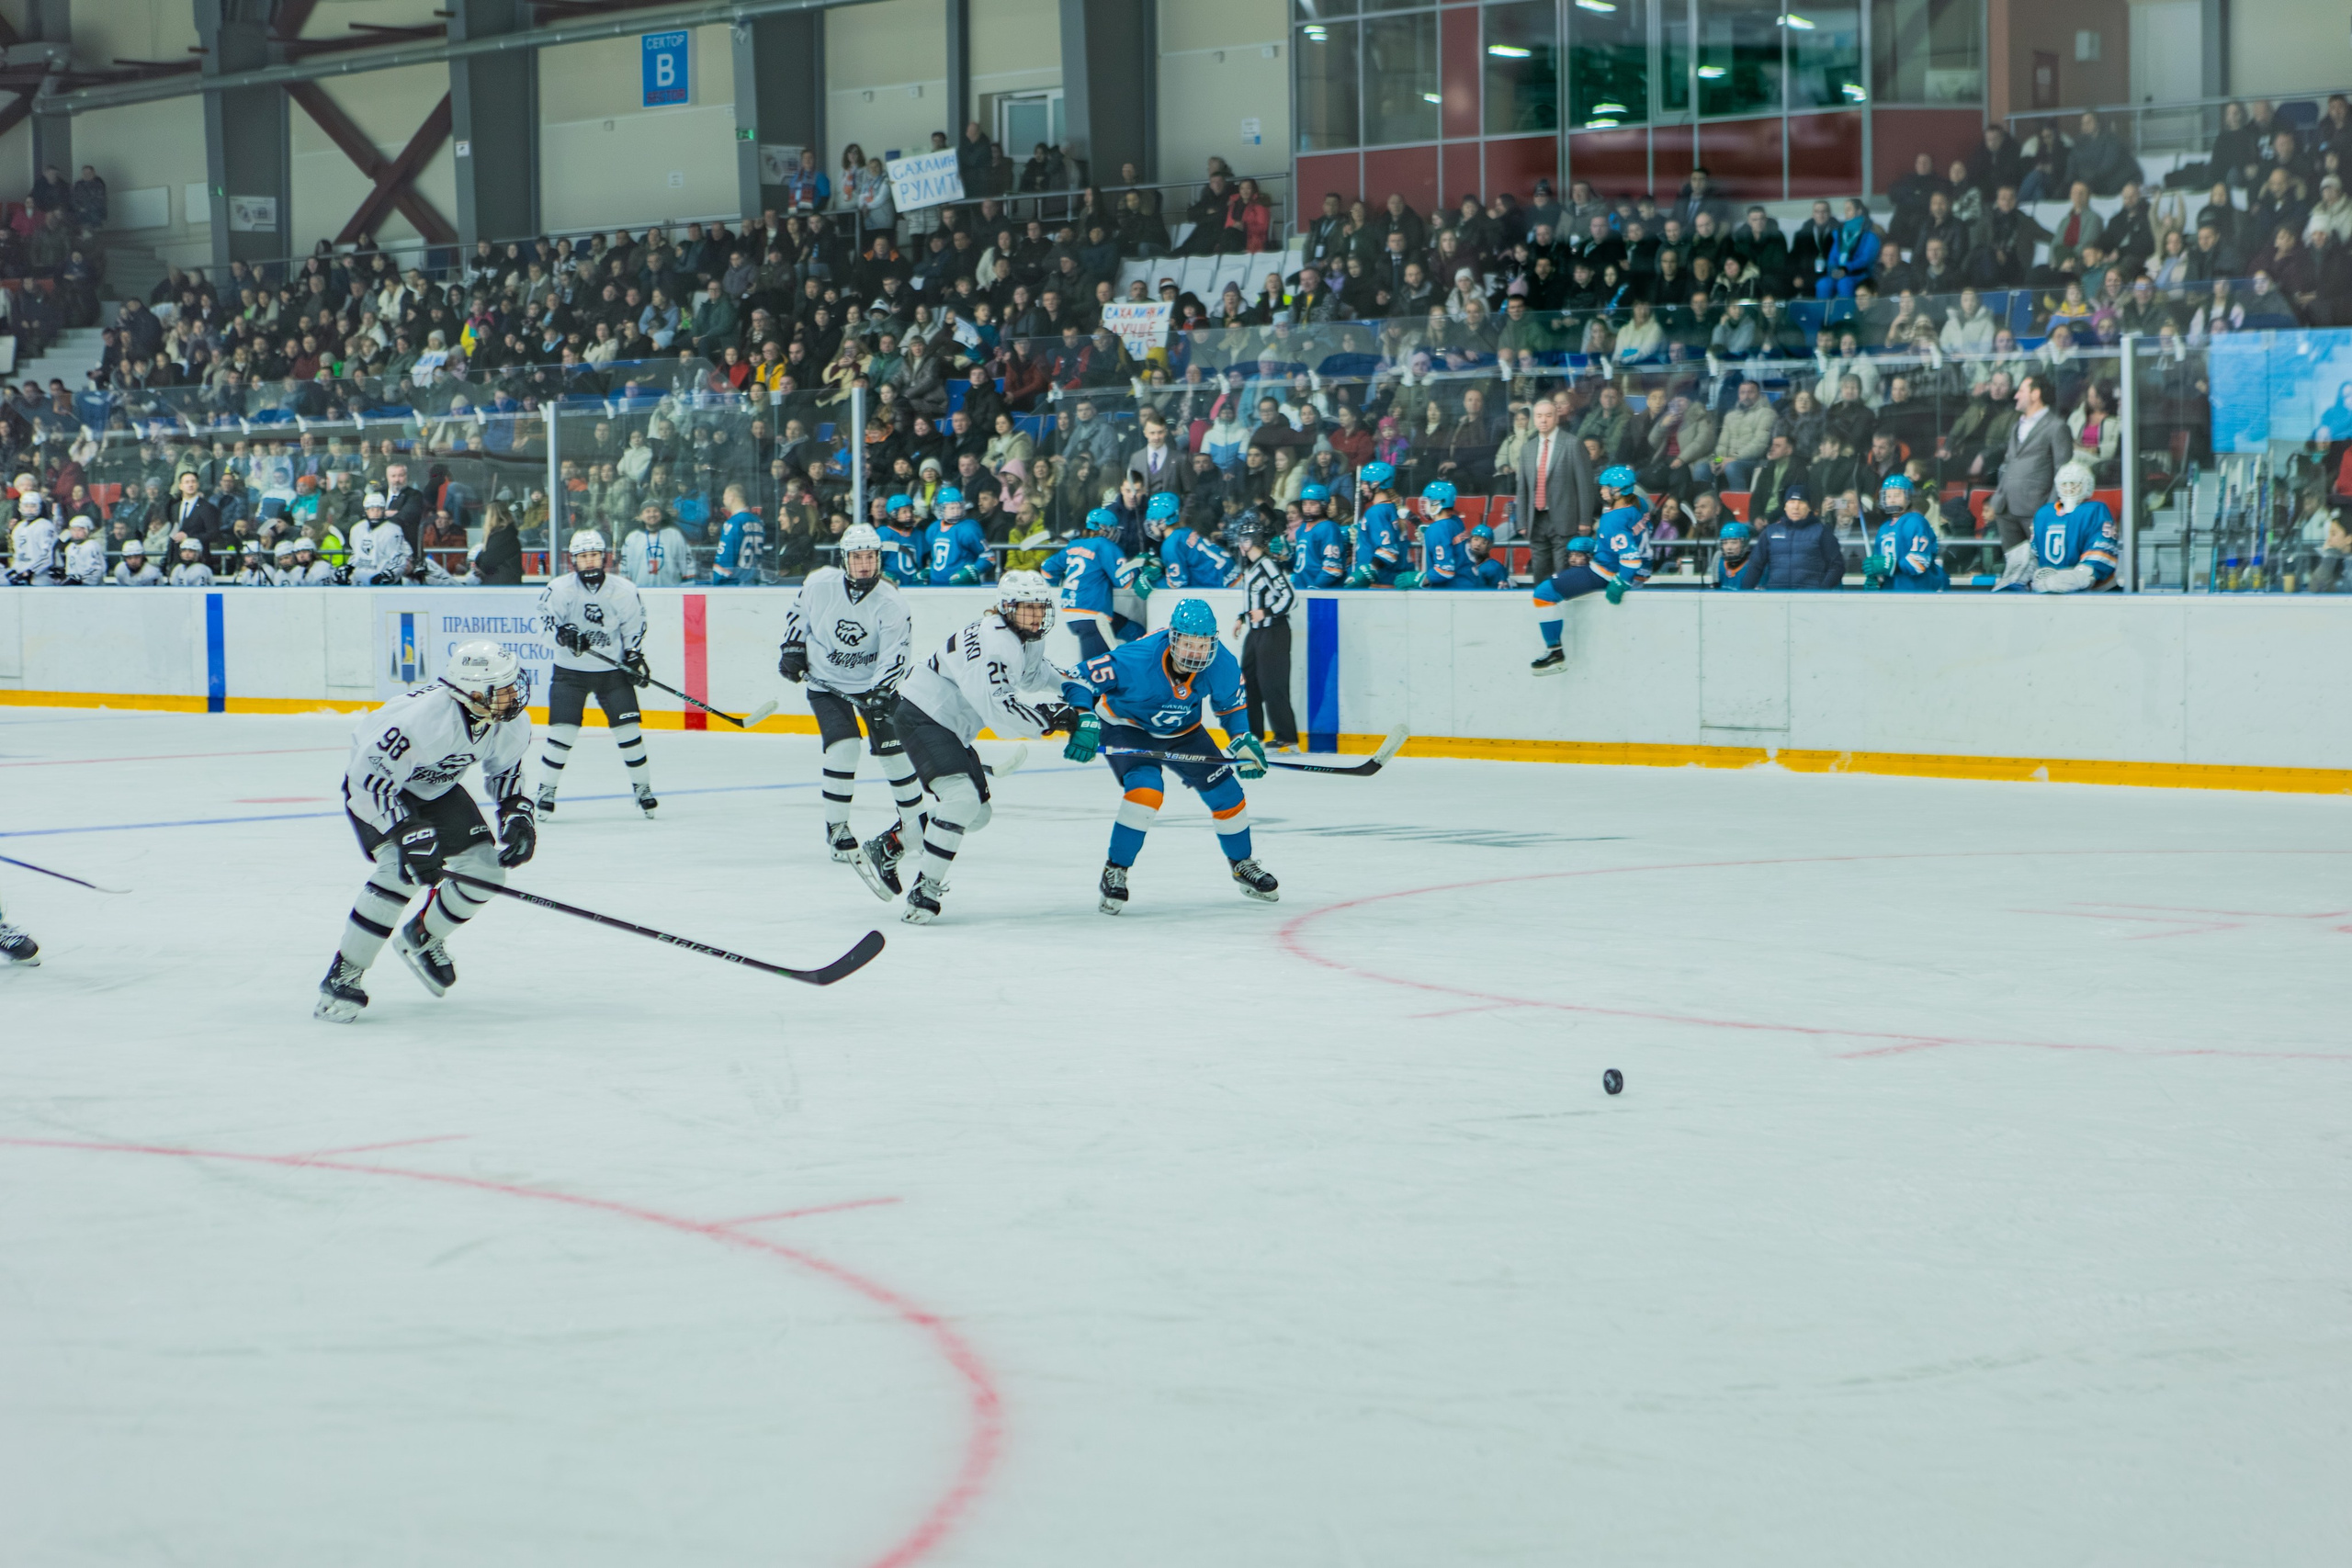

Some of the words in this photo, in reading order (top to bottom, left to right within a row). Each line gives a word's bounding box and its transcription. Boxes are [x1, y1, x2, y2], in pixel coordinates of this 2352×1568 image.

[1910, 536, 1929, 552] 17
[443, 617, 537, 634] ПРАВИТЕЛЬС
[964, 619, 982, 662] ЕНКО
[1086, 654, 1116, 684] 15
[1080, 720, 1102, 729] BAU
[377, 727, 411, 761] 98
[881, 739, 901, 750] BAU
[1171, 752, 1207, 762] BAUER
